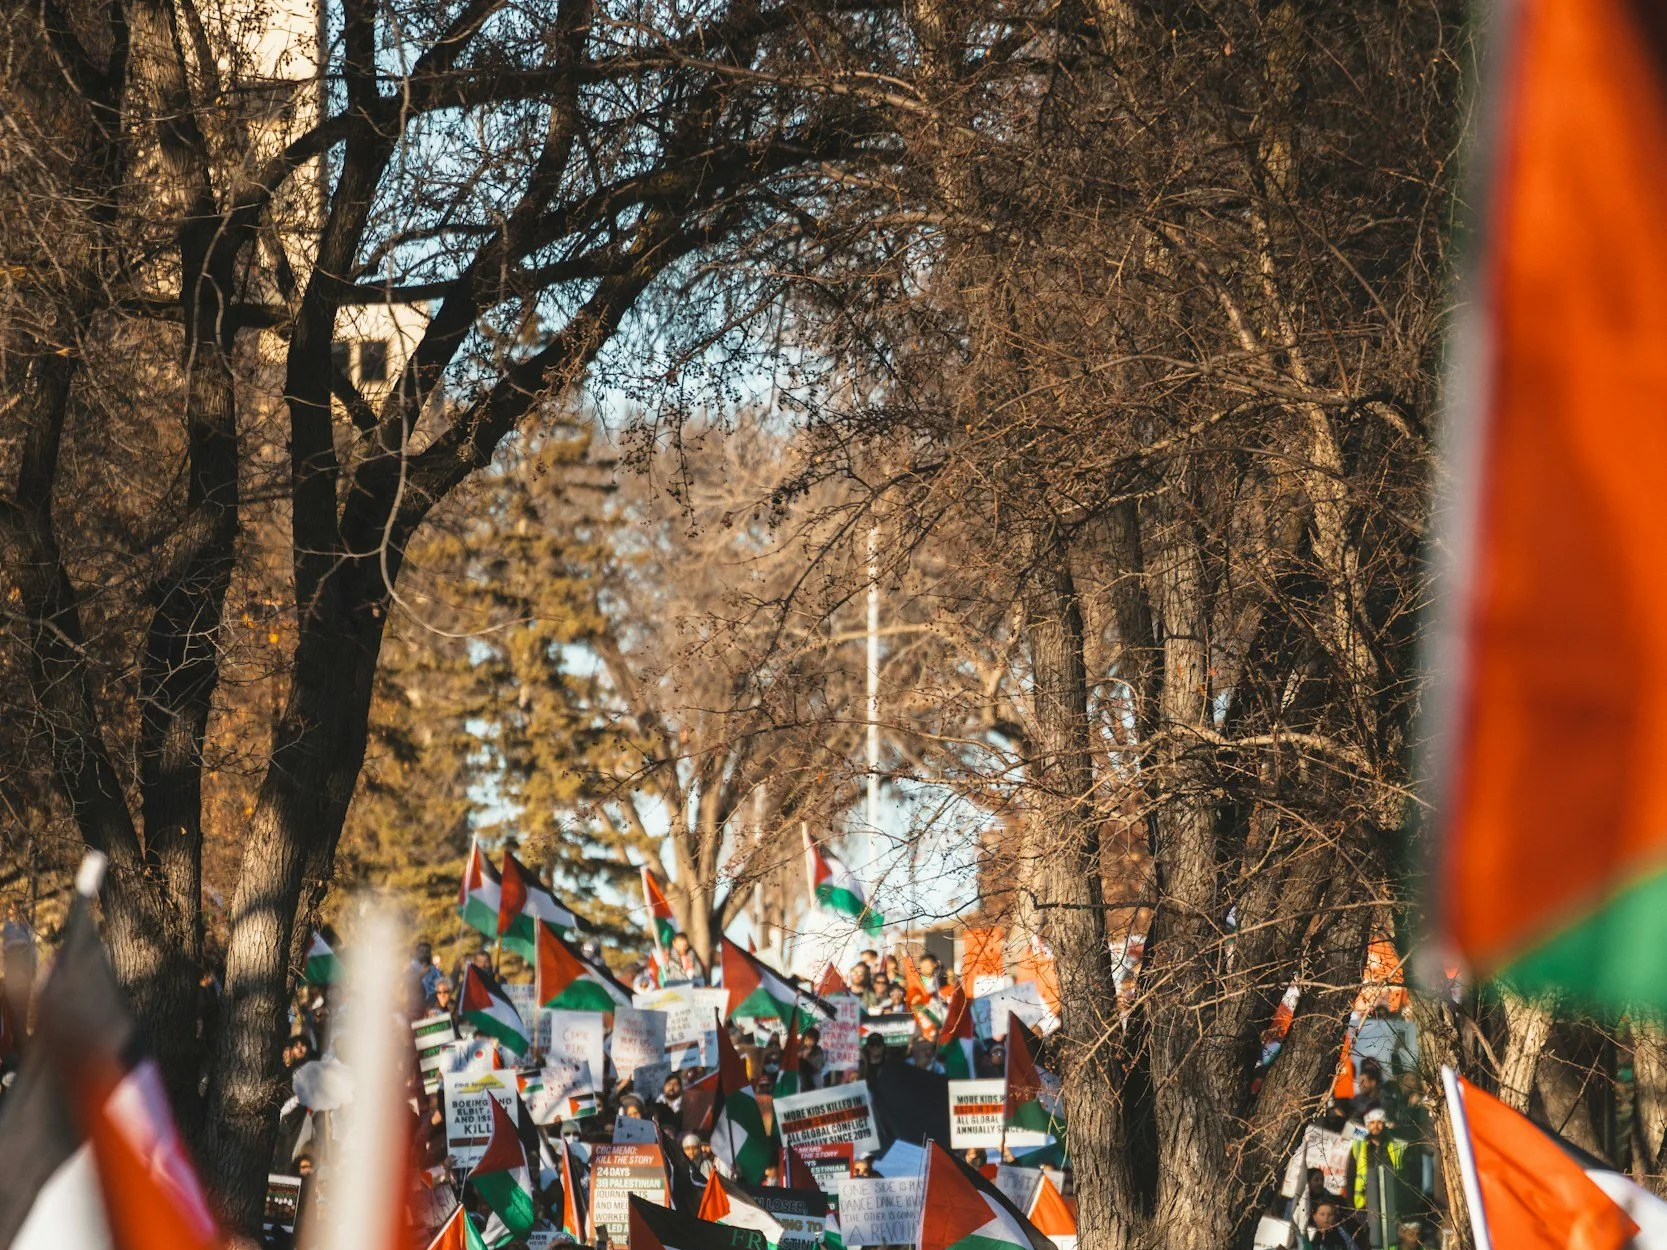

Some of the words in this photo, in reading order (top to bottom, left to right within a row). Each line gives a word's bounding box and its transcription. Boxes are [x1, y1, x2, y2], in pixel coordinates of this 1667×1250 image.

[452, 1099, 488, 1108] BOEING
[957, 1095, 978, 1104] MORE
[980, 1095, 998, 1104] KIDS
[456, 1107, 483, 1116] ELBIT
[784, 1109, 806, 1121] MORE
[806, 1104, 826, 1117] KIDS
[826, 1099, 851, 1112] KILLED
[454, 1115, 475, 1124] AND
[464, 1124, 492, 1135] KILL
[787, 1132, 801, 1143] ALL
[801, 1126, 830, 1140] GLOBAL
[831, 1118, 868, 1133] CONFLICT
[829, 1132, 853, 1144] SINCE
[854, 1128, 871, 1140] 2019
[596, 1155, 612, 1164] KILL
[613, 1155, 629, 1164] THE
[629, 1155, 655, 1165] STORY
[597, 1167, 609, 1177] 24
[610, 1167, 630, 1177] DAYS
[811, 1165, 846, 1173] ESTINIAN
[610, 1179, 660, 1188] PALESTINIAN
[875, 1181, 895, 1194] SIDE
[596, 1213, 629, 1222] WORKER
[871, 1221, 915, 1242] REVOLU
